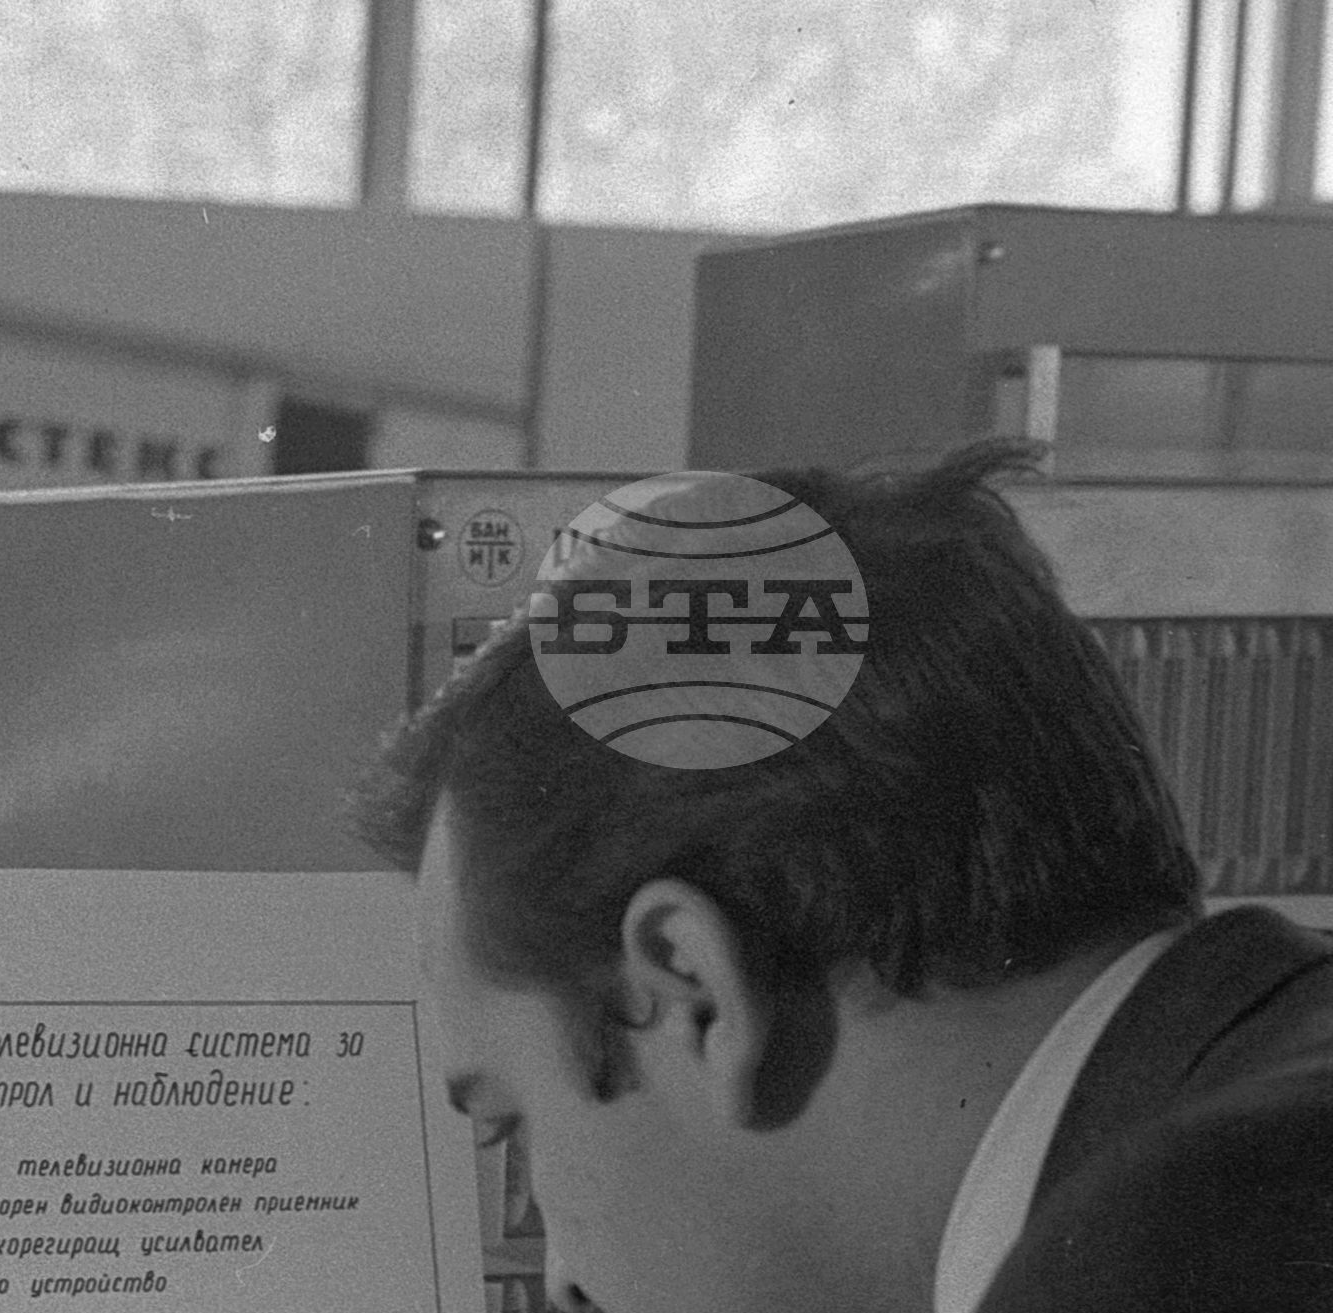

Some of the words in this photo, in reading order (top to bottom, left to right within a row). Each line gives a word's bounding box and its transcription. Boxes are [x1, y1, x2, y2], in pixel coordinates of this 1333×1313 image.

[183, 1031, 312, 1059] система
[335, 1030, 365, 1059] за
[74, 1081, 94, 1108] и
[16, 1152, 182, 1178] телевизионна
[200, 1156, 278, 1179] камера
[253, 1194, 360, 1216] приемник
[140, 1228, 264, 1257] усилвател
[30, 1269, 168, 1299] устройство
